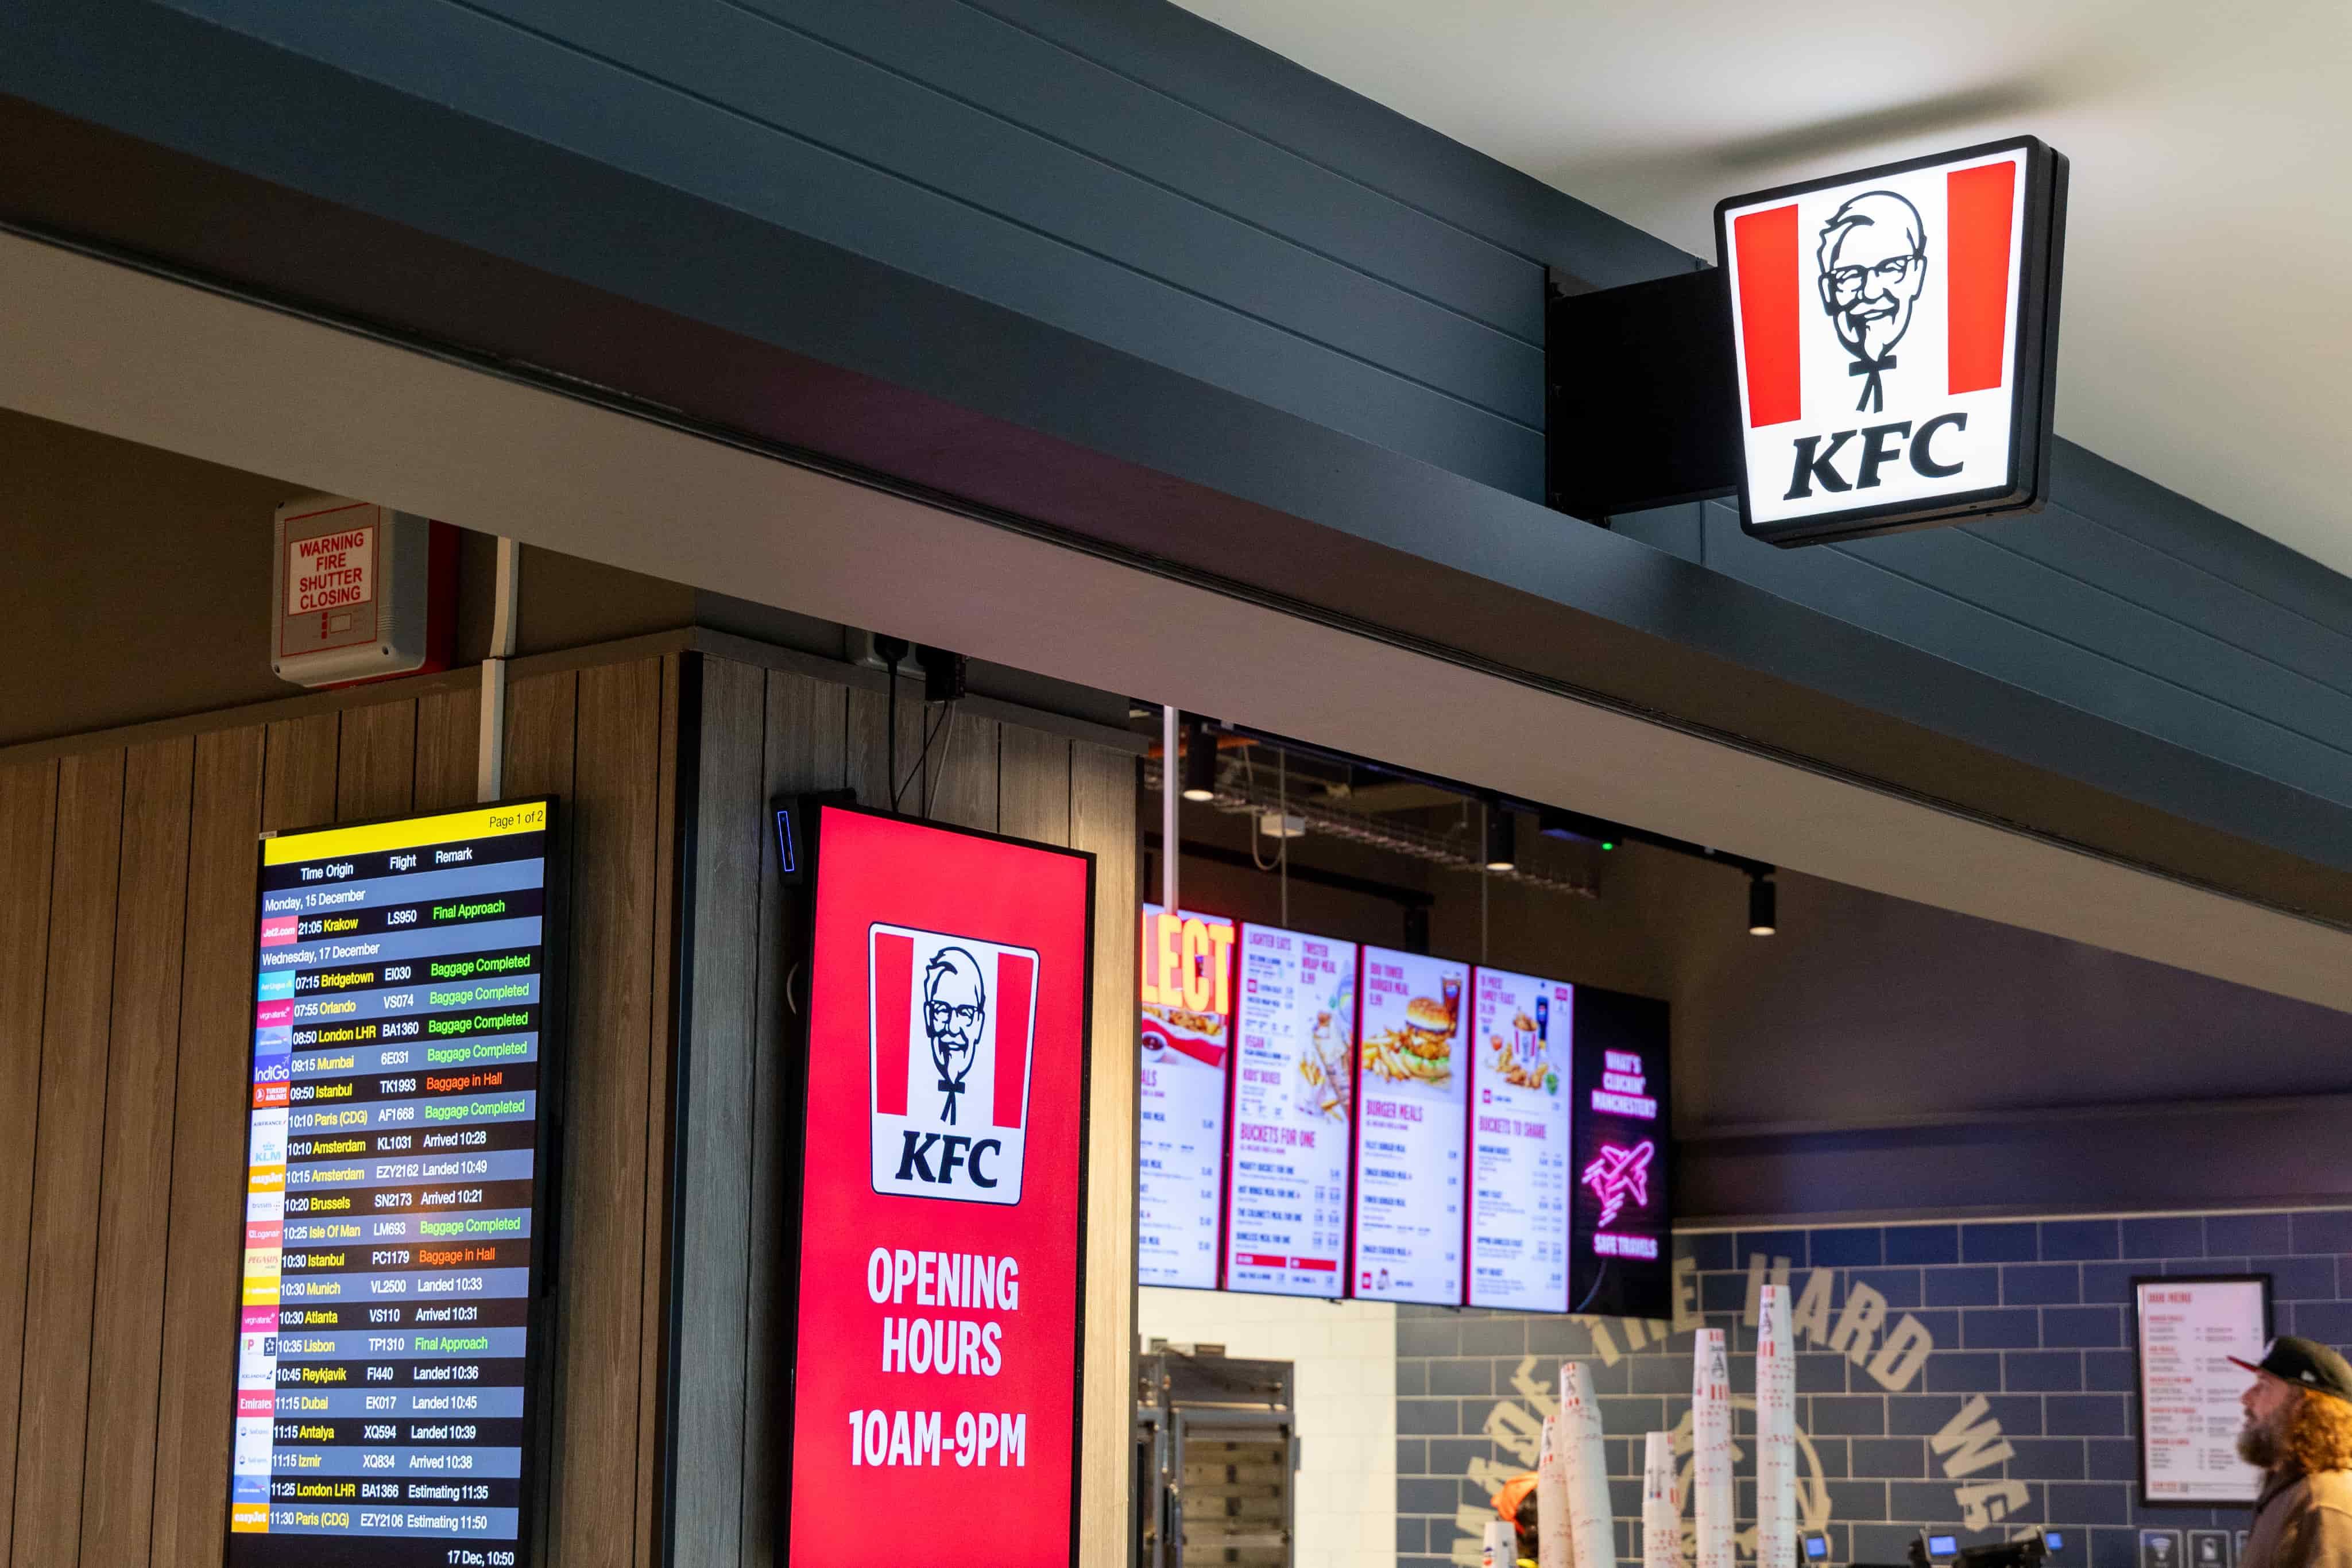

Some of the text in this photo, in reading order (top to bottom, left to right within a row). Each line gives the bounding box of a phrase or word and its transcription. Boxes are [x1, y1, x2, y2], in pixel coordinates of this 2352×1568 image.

[1783, 412, 1968, 501] KFC
[300, 532, 364, 558] WARNING
[316, 553, 346, 571] FIRE
[300, 567, 362, 593] SHUTTER
[300, 586, 361, 610] CLOSING
[489, 810, 543, 829] Page 1 of 2
[300, 847, 473, 880] Time Origin Flight Remark
[265, 889, 366, 912] Monday, 15 December
[297, 900, 505, 935] 21:05 Krakow LS950 Final Approach
[262, 927, 295, 937] Jet2.com
[262, 943, 380, 966] Wednesday, 17 December
[295, 975, 320, 990] 07:15
[321, 972, 374, 988] Bridgetown
[431, 962, 474, 977] Baggage
[475, 954, 530, 972] Completed
[293, 982, 529, 1017] 07:55 Orlando VS074 Baggage Completed
[292, 1031, 317, 1045] 08:50
[318, 1028, 354, 1043] London
[355, 1025, 376, 1039] LHR
[382, 1021, 419, 1037] BA1360
[428, 1019, 472, 1035] Baggage
[474, 1011, 528, 1030] Completed
[291, 1040, 527, 1073] 09:15 Mumbai 6E031 Baggage Completed
[255, 1064, 289, 1081] IndiGo
[289, 1072, 502, 1100] 09:50 Istanbul TK1993 Baggage in Hall
[289, 1099, 525, 1128] 10:10 Paris (CDG) AF1668 Baggage Completed
[287, 1130, 486, 1156] 10:10 Amsterdam KL1031 Arrived 10:28
[895, 1130, 1001, 1188] KFC
[286, 1160, 487, 1183] 10:15 Amsterdam EZY2162 Landed 10:49
[285, 1189, 482, 1211] 10:20 Brussels SN2173 Arrived 10:21
[283, 1217, 521, 1240] 10:25 Isle Of Man LM693 Baggage Completed
[282, 1247, 495, 1268] 10:30 Istanbul PC1179 Baggage in Hall
[281, 1283, 305, 1296] 10:30
[306, 1281, 341, 1295] Munich
[370, 1279, 406, 1293] VL2500
[417, 1277, 454, 1292] Landed
[456, 1277, 482, 1291] 10:33
[867, 1246, 1019, 1311] OPENING
[279, 1306, 477, 1325] 10:30 Atlanta VS110 Arrived 10:31
[1743, 1253, 1933, 1392] HARD
[278, 1336, 488, 1353] 10:35 Lisbon TP1310 Final Approach
[882, 1317, 1002, 1376] HOURS
[277, 1365, 478, 1384] 10:45 Reykjavik FI440 Landed 10:36
[240, 1398, 272, 1409] Emirates
[275, 1395, 477, 1410] 11:15 Dubai EK017 Landed 10:45
[274, 1425, 298, 1438] 11:15
[299, 1425, 334, 1441] Antalya
[363, 1424, 396, 1439] XQ594
[411, 1425, 448, 1439] Landed
[450, 1425, 476, 1439] 10:39
[849, 1409, 1027, 1467] 10AM-9PM
[272, 1454, 297, 1467] 11:15
[298, 1454, 322, 1467] Izmir
[362, 1454, 395, 1468] XQ834
[409, 1455, 444, 1469] Arrived
[446, 1455, 473, 1469] 10:38
[270, 1482, 488, 1501] 11:25 London LHR BA1366 Estimating 11:35
[270, 1511, 487, 1531] 11:30 Paris (CDG) EZY2106 Estimating 11:50
[447, 1550, 514, 1567] 17 Dec, 10:50
